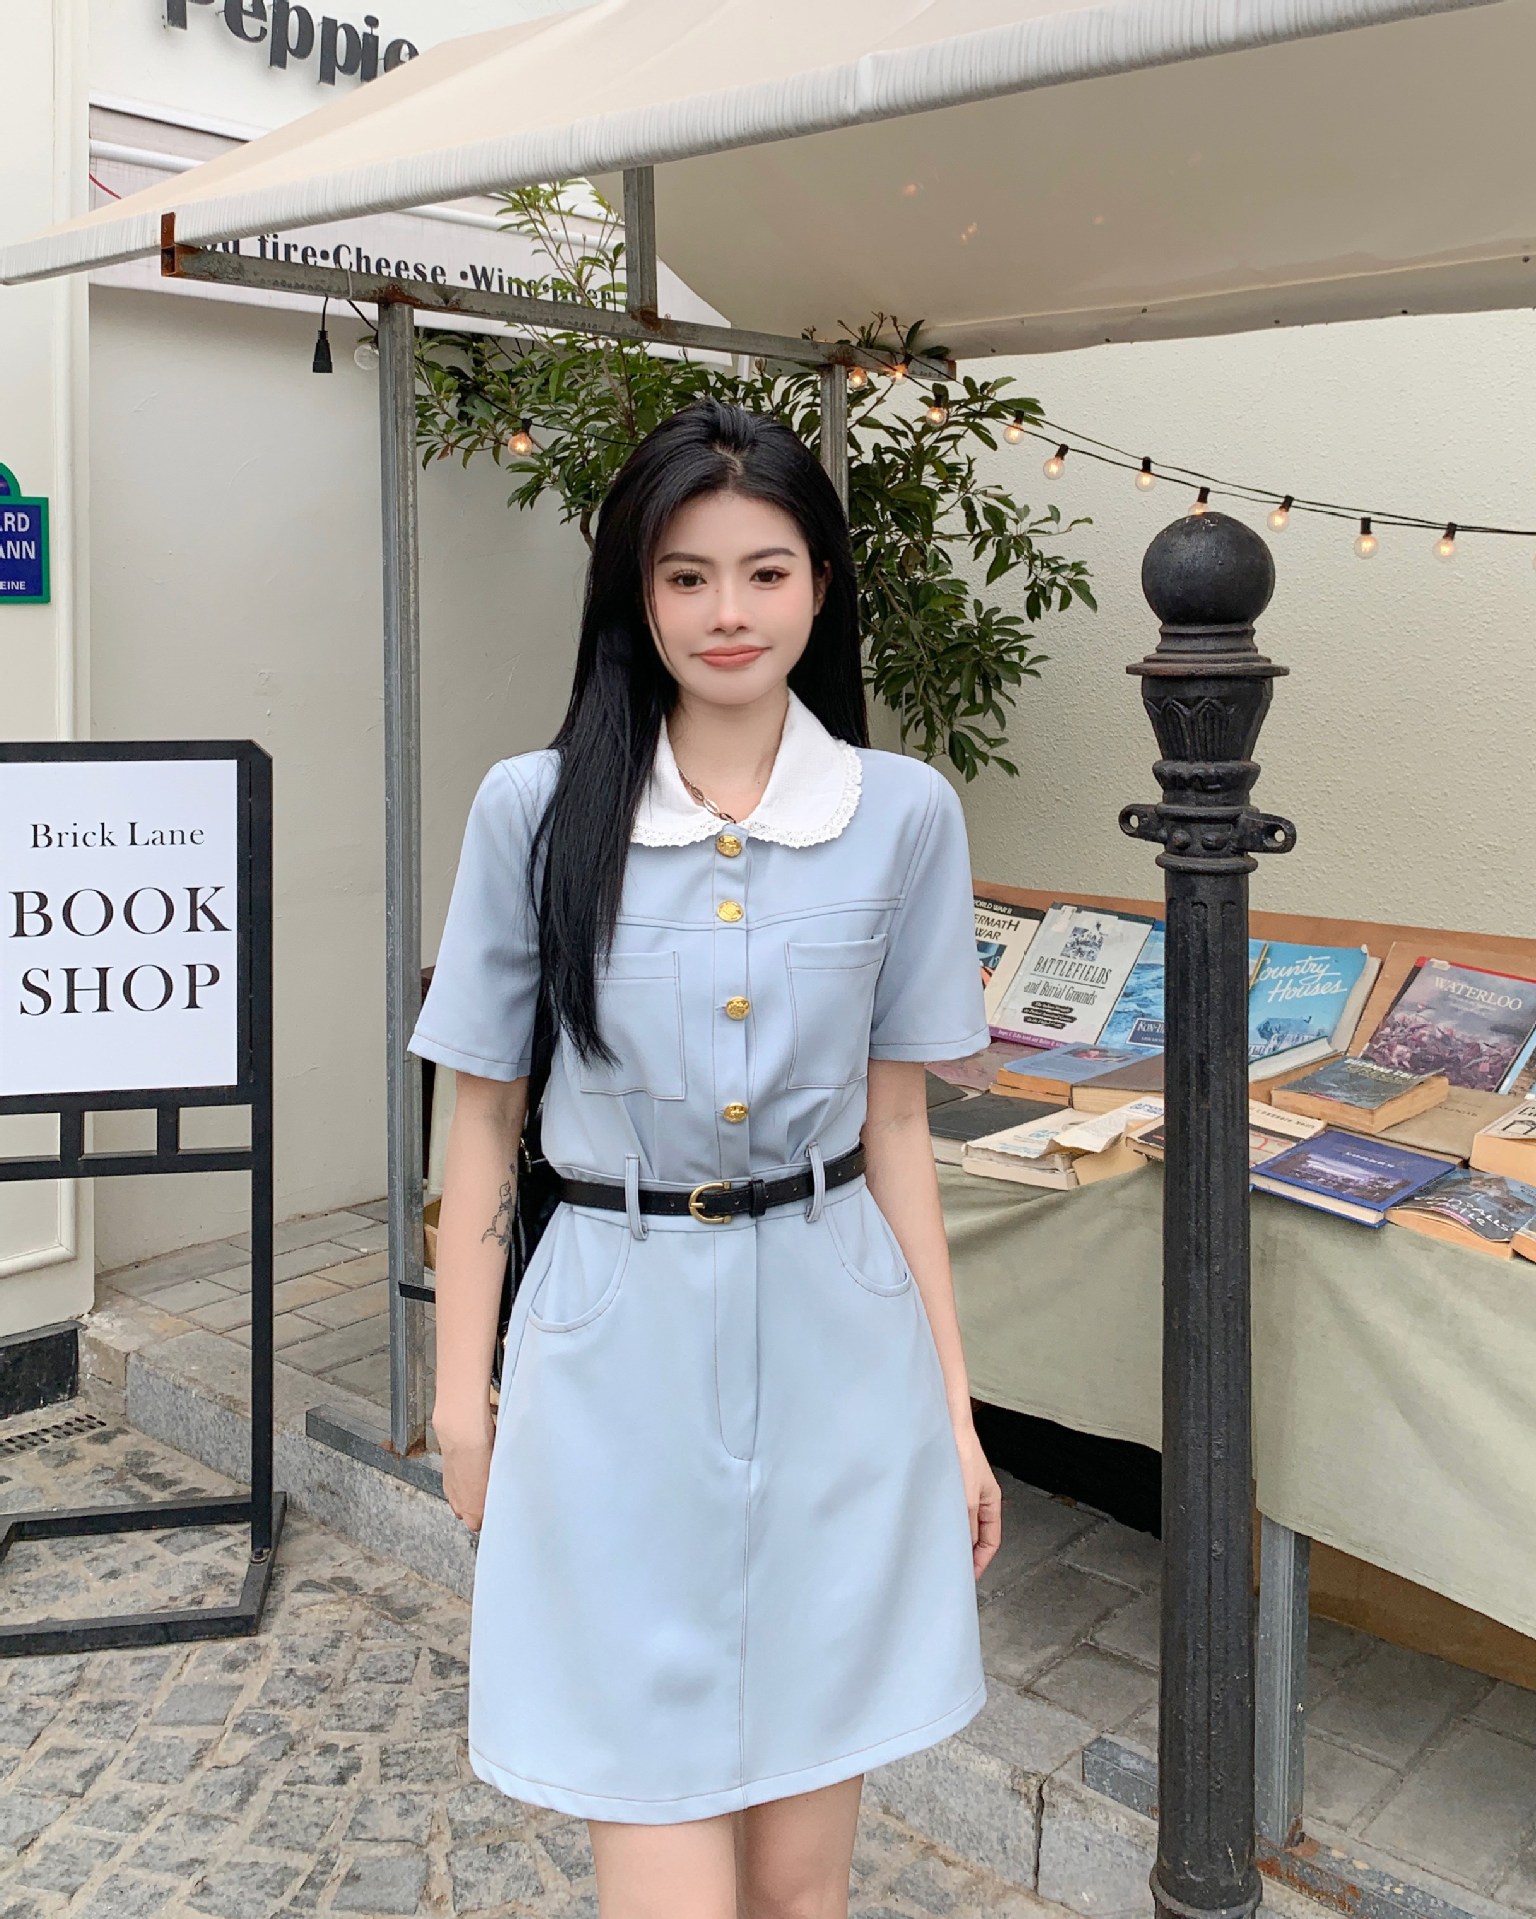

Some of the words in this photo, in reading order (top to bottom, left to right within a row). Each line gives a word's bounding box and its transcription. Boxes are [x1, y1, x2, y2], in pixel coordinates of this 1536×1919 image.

[0, 511, 30, 532] RD
[0, 581, 26, 590] EINE
[30, 822, 118, 848] Brick
[127, 821, 205, 846] Lane
[8, 886, 232, 938] BOOK
[974, 899, 993, 909] ORLD
[1034, 956, 1112, 984] BATTLEFIELDS
[20, 963, 220, 1016] SHOP
[1024, 980, 1043, 994] and
[1039, 981, 1067, 999] Burial
[1065, 986, 1097, 1005] Grounds
[1267, 979, 1348, 1003] Houses
[1435, 976, 1522, 1010] WATERLOO
